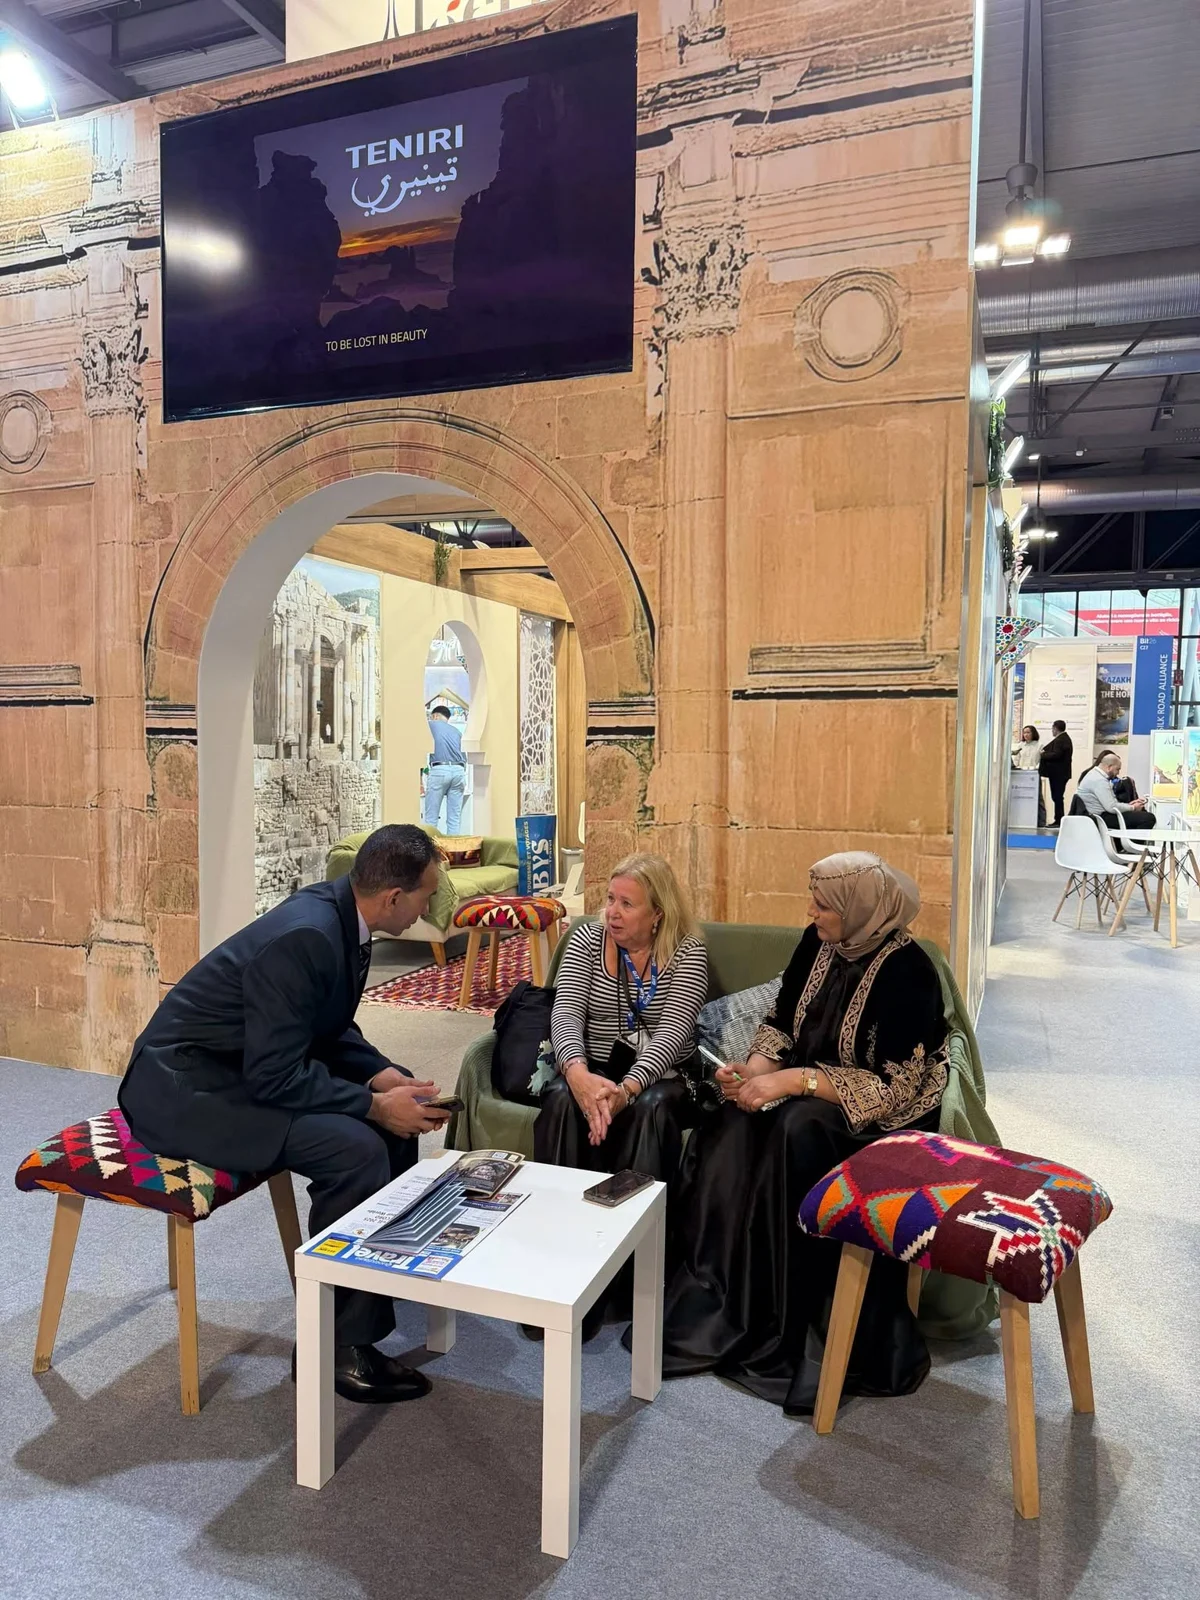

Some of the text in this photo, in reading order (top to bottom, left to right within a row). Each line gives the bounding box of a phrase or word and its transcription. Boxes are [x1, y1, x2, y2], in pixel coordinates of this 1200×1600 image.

[345, 124, 463, 169] TENIRI
[325, 328, 428, 352] TO BE LOST IN BEAUTY
[1158, 654, 1169, 690] ALLIANCE
[1157, 692, 1166, 715] ROAD
[523, 821, 531, 850] VOYAGES
[526, 851, 532, 860] ET
[341, 1244, 415, 1270] Travel
